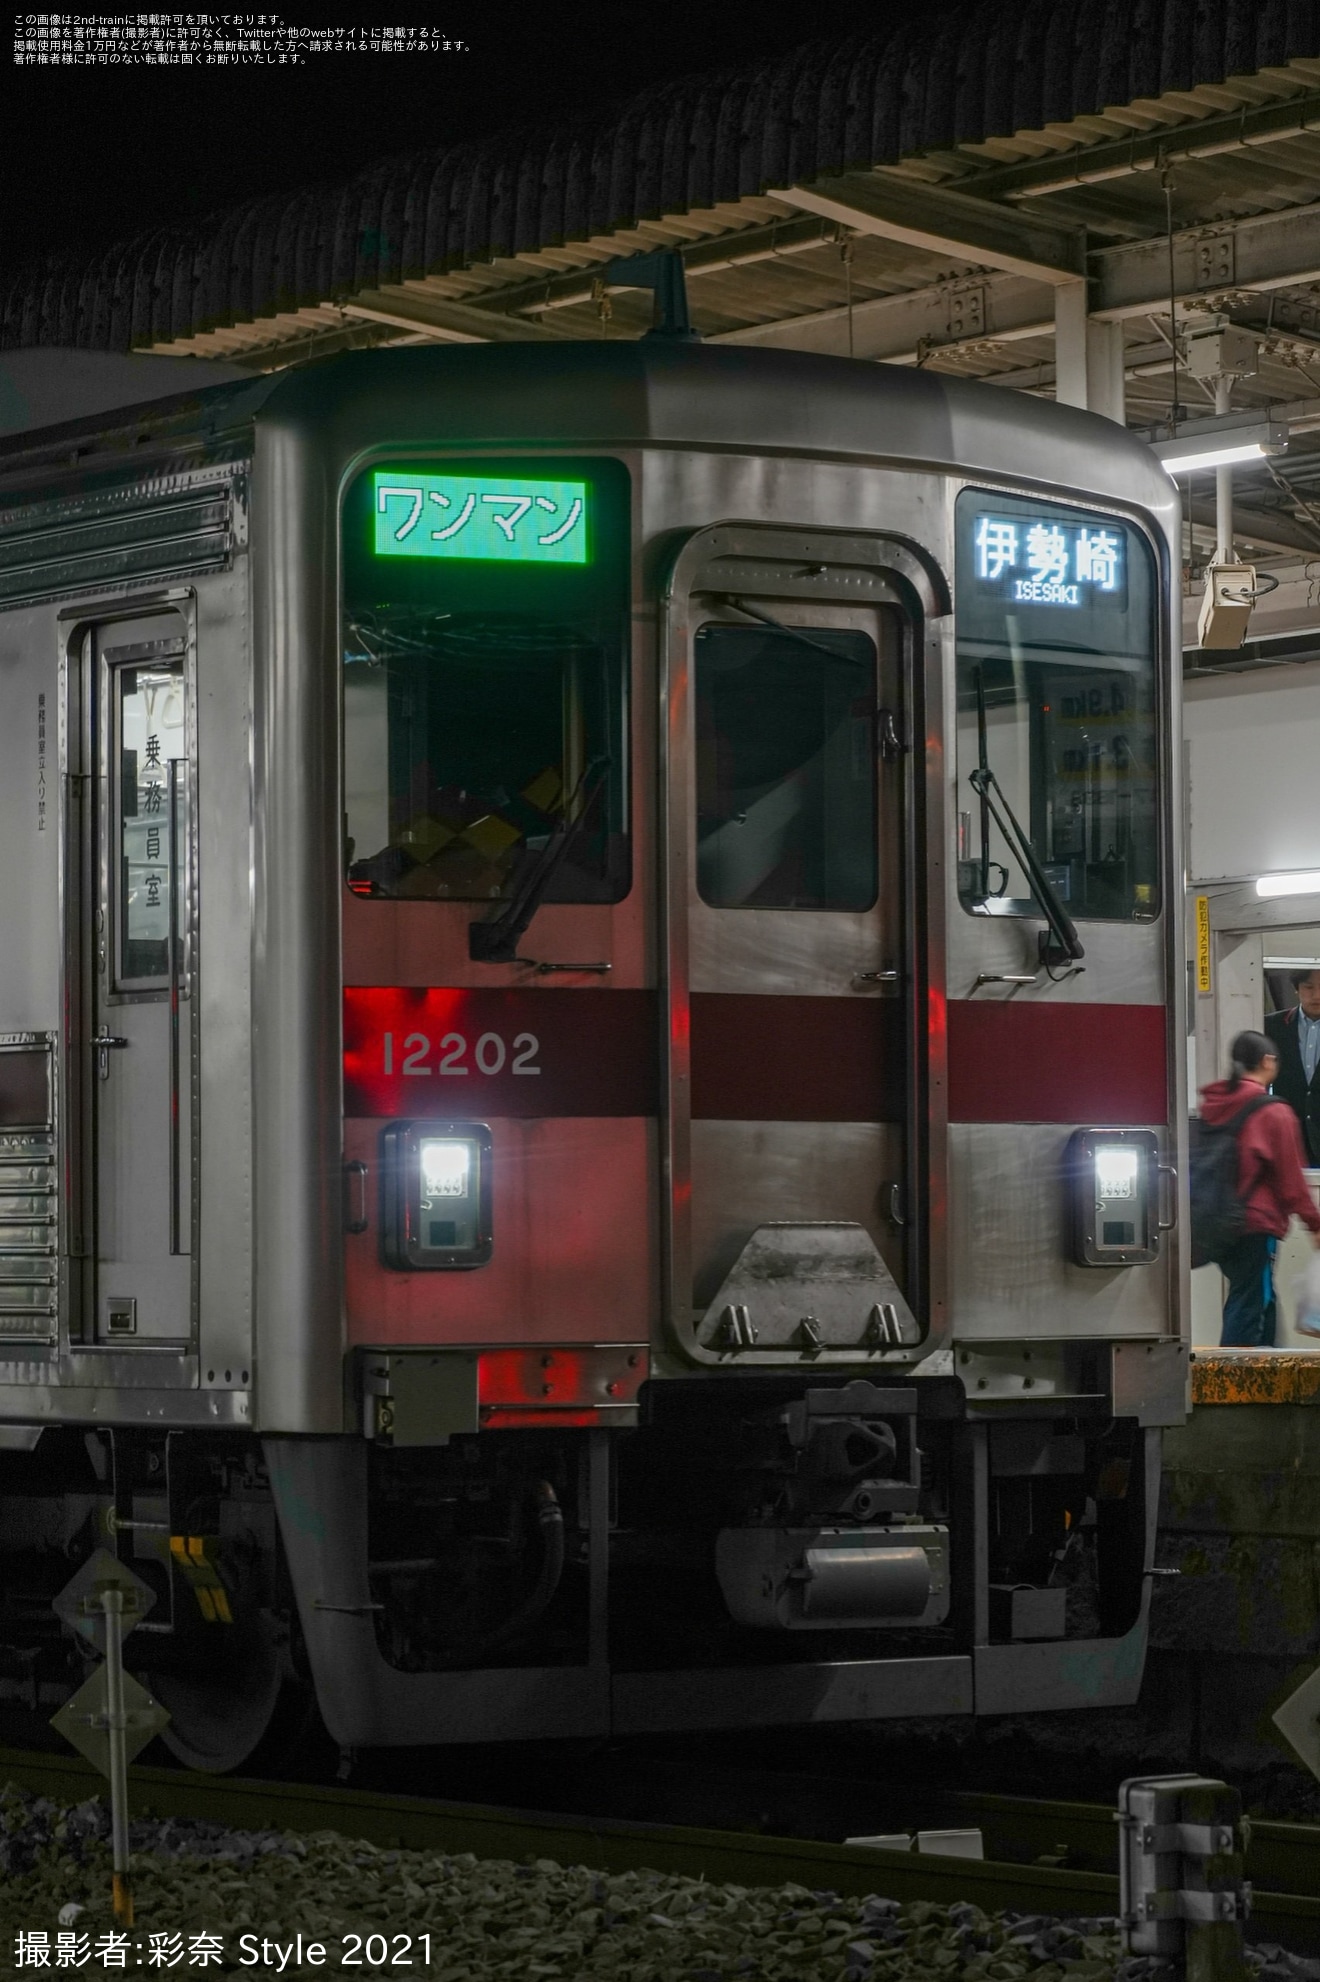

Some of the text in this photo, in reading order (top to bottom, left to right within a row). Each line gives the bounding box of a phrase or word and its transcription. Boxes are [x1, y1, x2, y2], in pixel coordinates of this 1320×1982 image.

[377, 486, 584, 546] ワンマン
[976, 517, 1118, 589] 伊勢崎
[1014, 579, 1079, 605] ISESAKI
[38, 693, 46, 831] 乗務員室立入り禁止
[144, 734, 163, 908] 乗務員室
[1198, 900, 1209, 988] 防犯カメラ作動中
[384, 1032, 541, 1075] 12202
